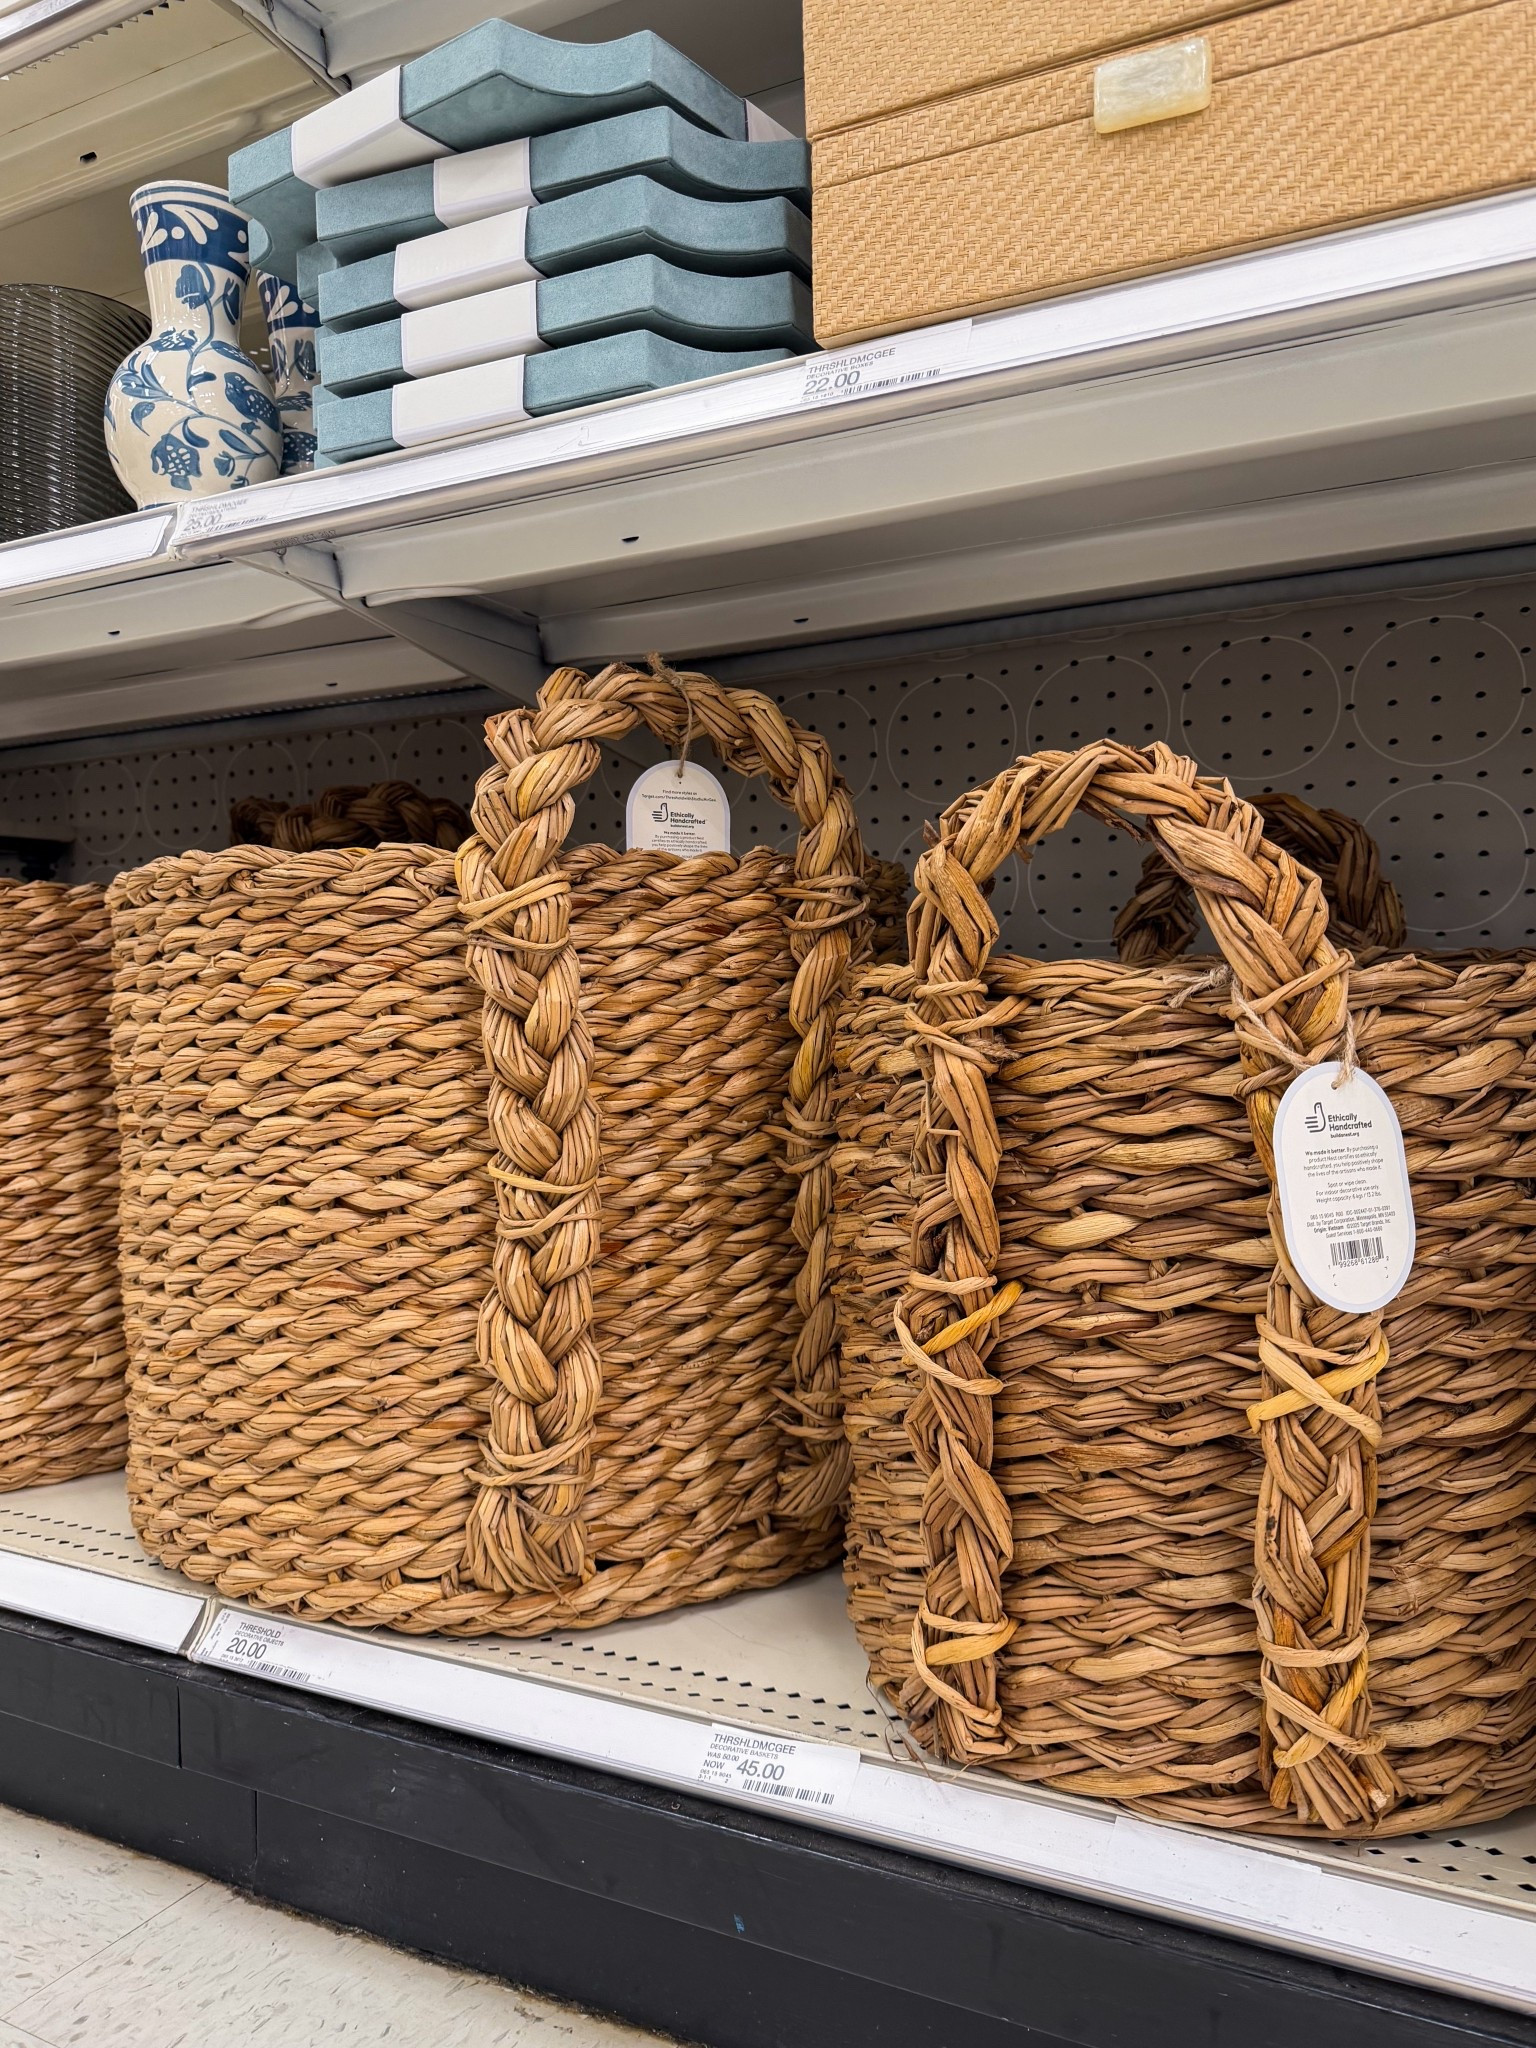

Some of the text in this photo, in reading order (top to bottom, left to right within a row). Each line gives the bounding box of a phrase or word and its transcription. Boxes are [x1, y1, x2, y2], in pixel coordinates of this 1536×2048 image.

[809, 347, 896, 374] THRSHLDMCGEE
[806, 361, 874, 380] DECORATIVE BOXES
[803, 370, 861, 396] 22.00
[184, 513, 222, 532] 25.00
[670, 812, 694, 820] Ethically
[1328, 1113, 1358, 1122] Ethically
[1329, 1120, 1372, 1132] Handcrafted
[235, 1631, 284, 1646] DECORATIVE OBJECTS
[239, 1622, 282, 1638] THRESHOLD
[226, 1637, 267, 1660] 20.00
[710, 1743, 778, 1760] DECORATIVE BASKETS
[714, 1734, 796, 1755] THRSHLDMCGEE
[707, 1751, 740, 1762] WAS 50.00
[703, 1759, 784, 1780] NOW 45.00
